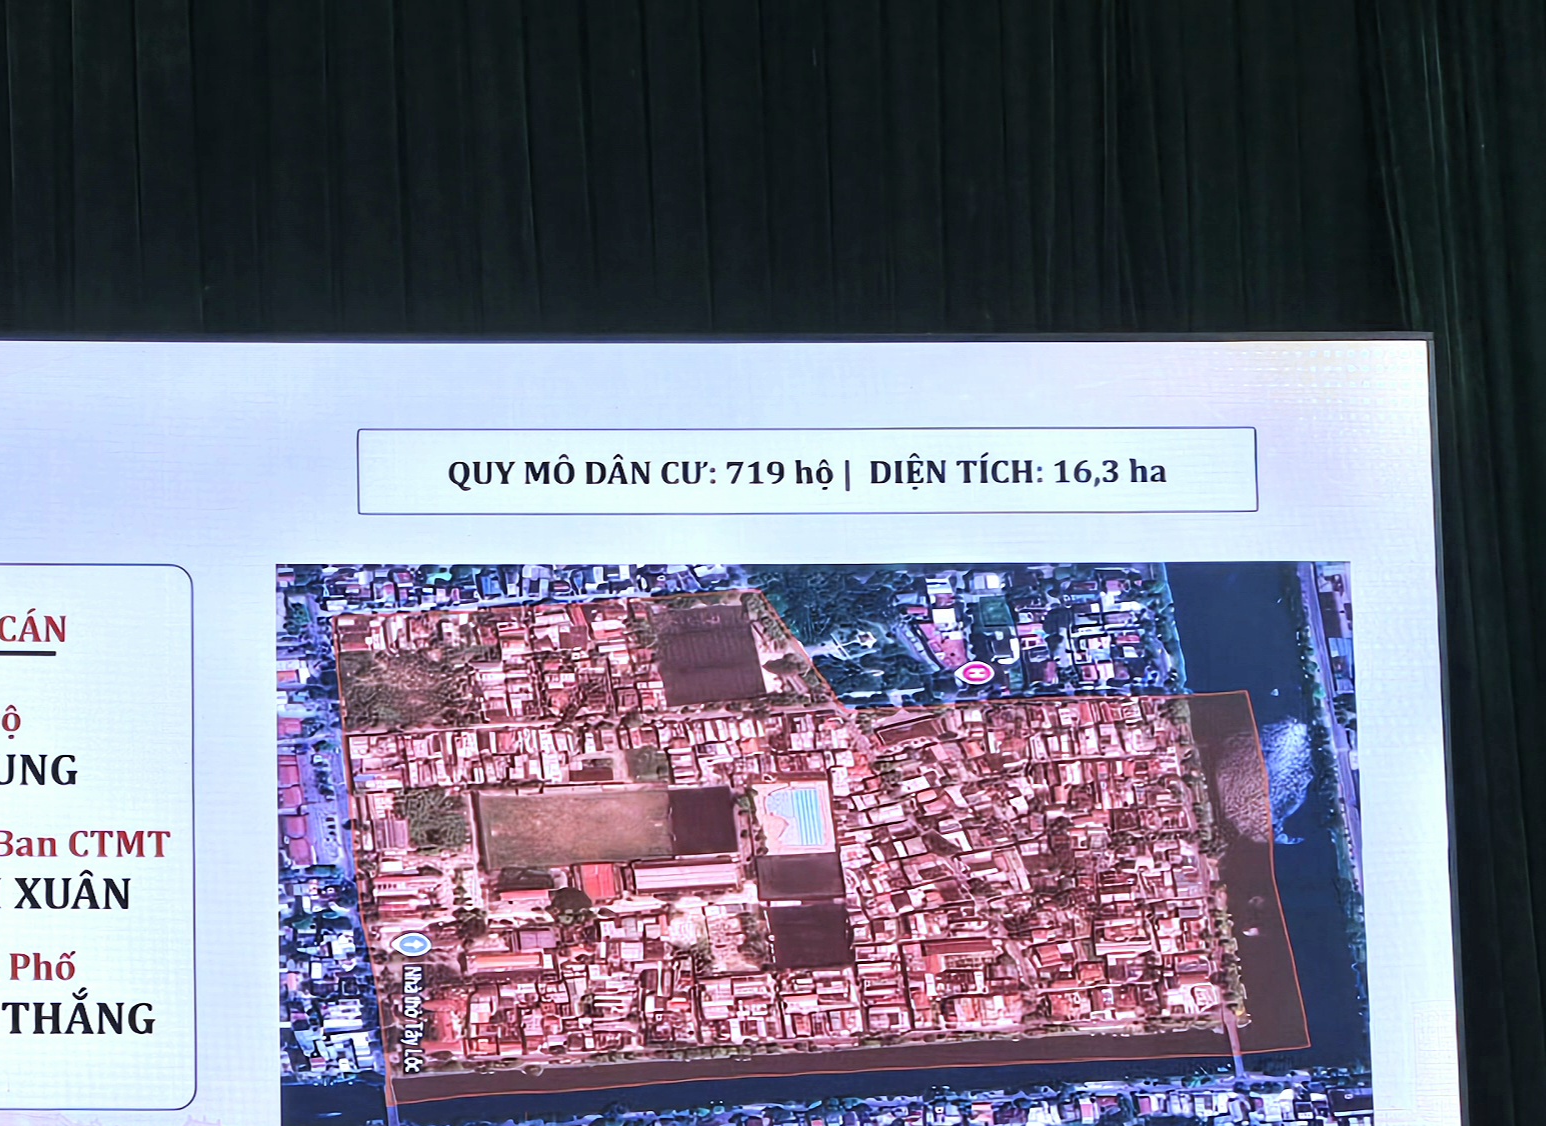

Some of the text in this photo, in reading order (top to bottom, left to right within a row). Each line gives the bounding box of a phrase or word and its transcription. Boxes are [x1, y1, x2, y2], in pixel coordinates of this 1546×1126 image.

[448, 461, 516, 492] QUY
[524, 453, 575, 485] MÔ
[585, 453, 651, 485] DÂN
[660, 461, 717, 486] CƯ:
[726, 461, 785, 485] 719
[794, 458, 834, 492] hộ
[870, 452, 947, 491] DIỆN
[955, 451, 1044, 484] TÍCH:
[1053, 459, 1119, 489] 16,3
[1128, 458, 1167, 483] ha
[68, 830, 171, 858] CTMT
[13, 869, 131, 910] XUÂN
[9, 950, 76, 981] Phố
[1, 987, 156, 1035] THẮNG
